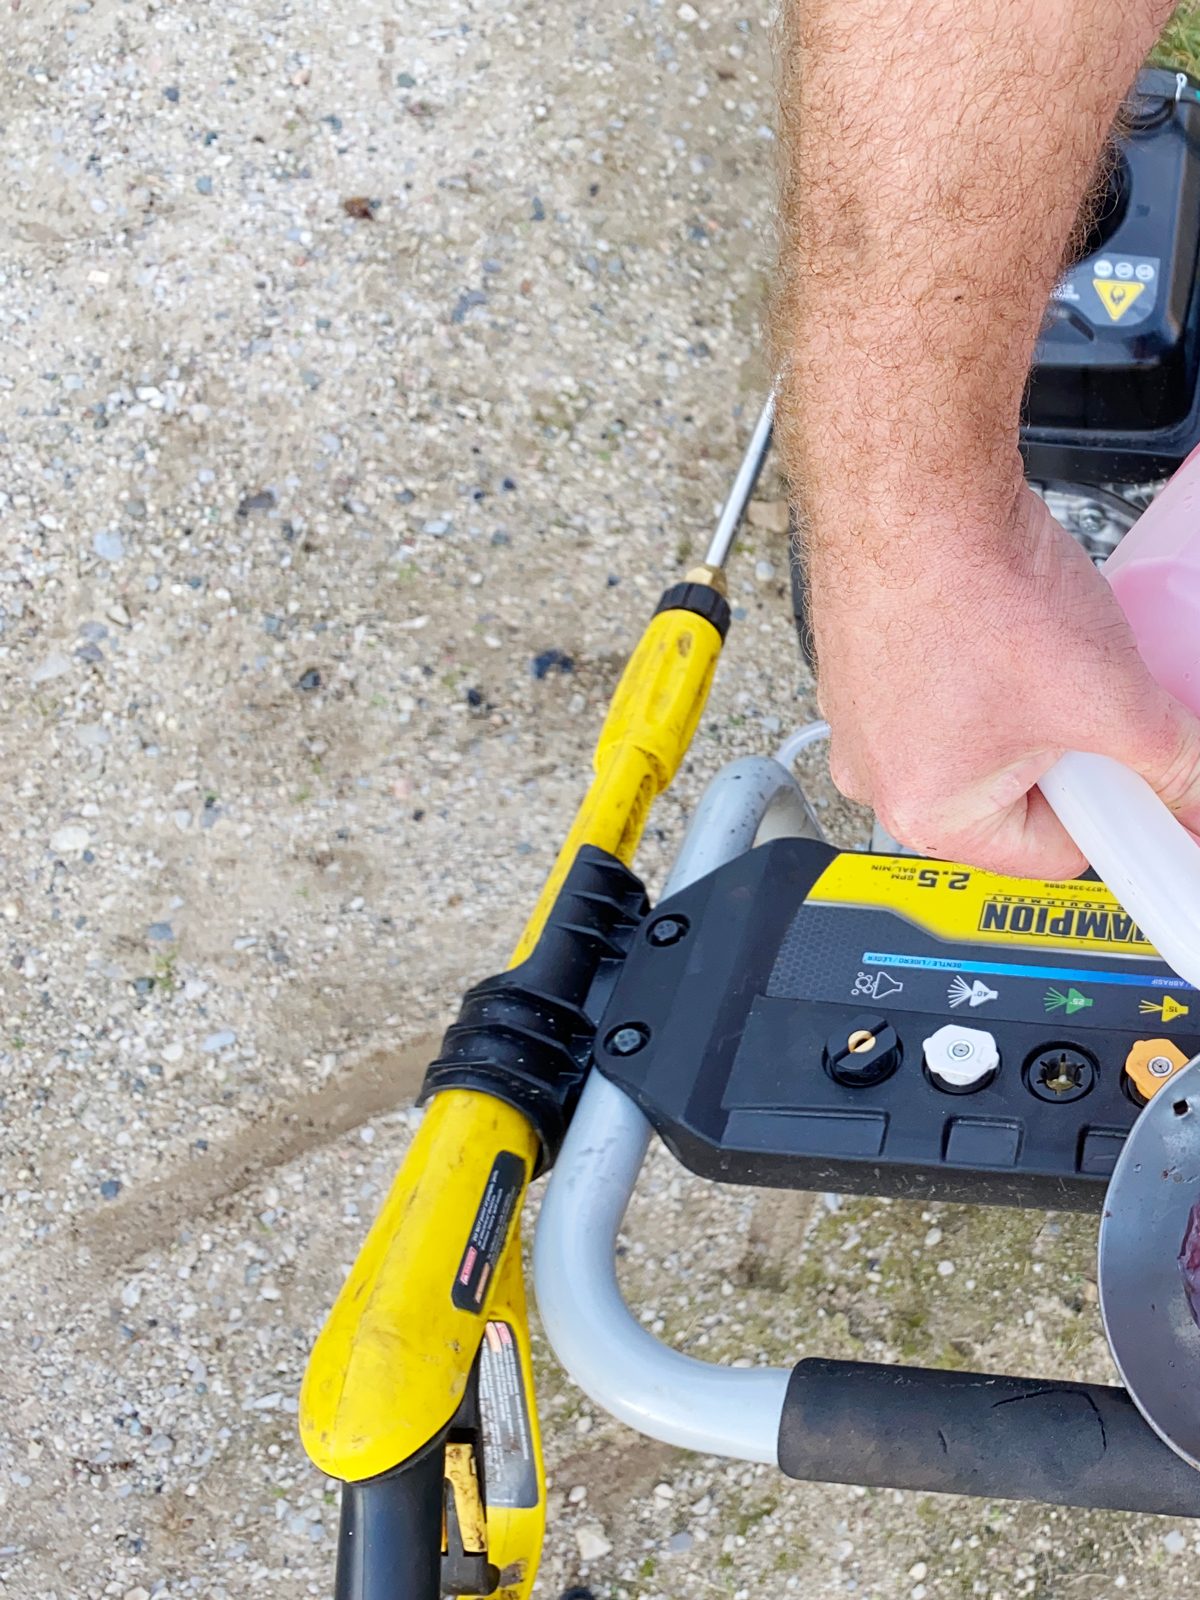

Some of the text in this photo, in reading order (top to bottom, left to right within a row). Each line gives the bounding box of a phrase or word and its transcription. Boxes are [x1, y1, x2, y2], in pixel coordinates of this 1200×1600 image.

[917, 868, 970, 889] 2.5
[990, 895, 1104, 909] EQUIPMENT
[982, 902, 1149, 942] AMPION
